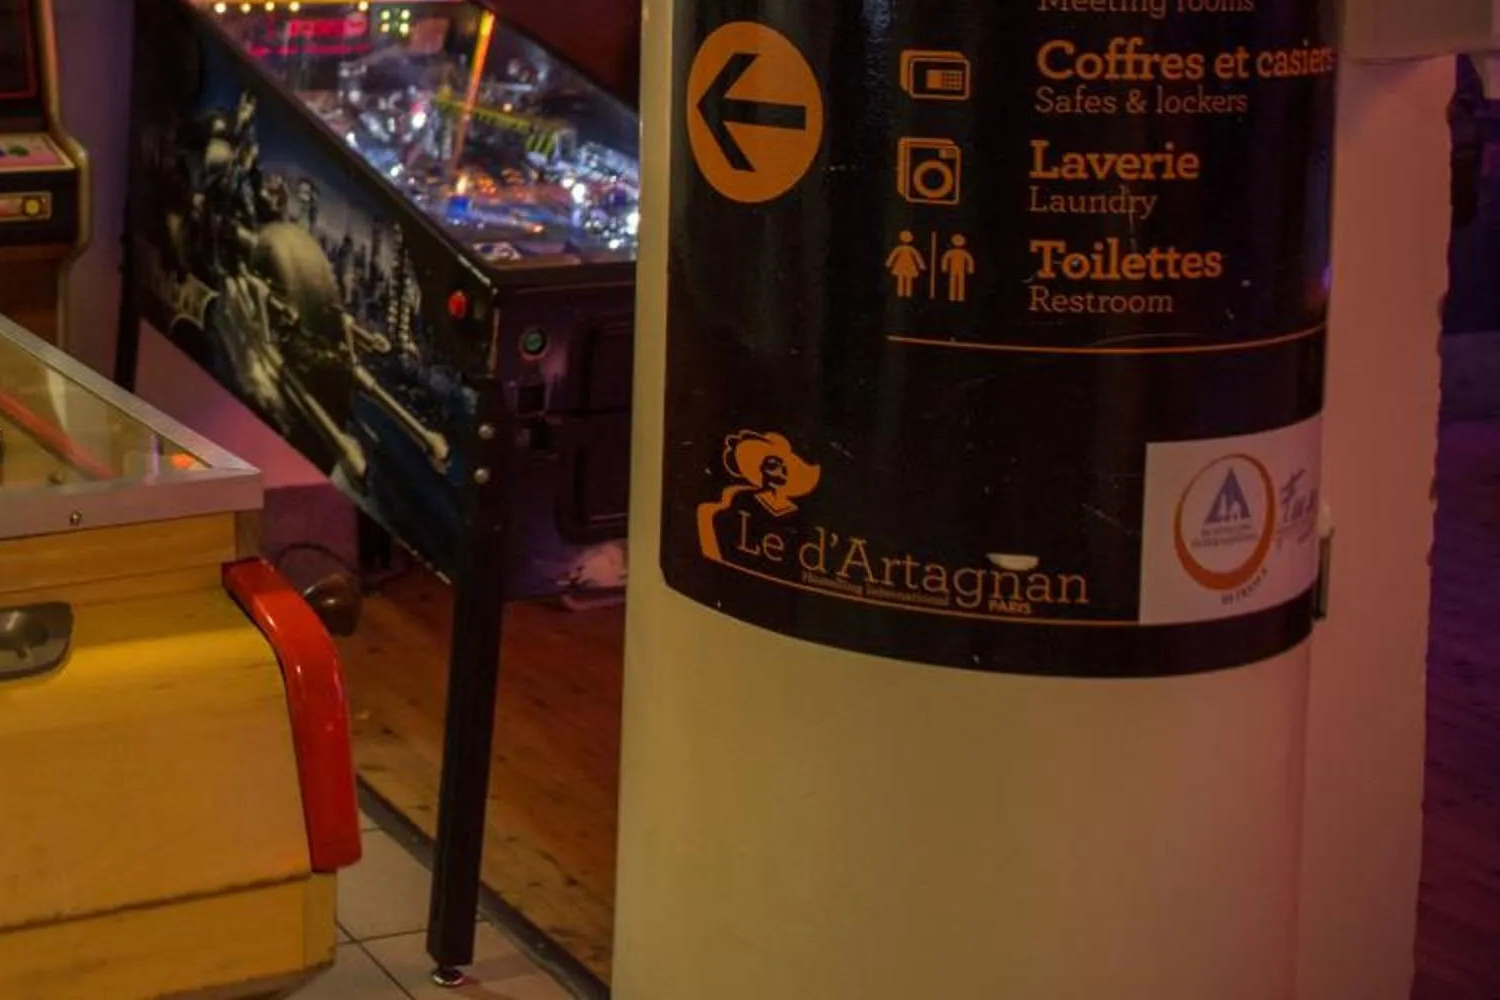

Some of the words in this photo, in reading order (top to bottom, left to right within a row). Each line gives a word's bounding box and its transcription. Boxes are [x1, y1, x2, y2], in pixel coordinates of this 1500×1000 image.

[1037, 36, 1206, 80] Coffres
[1214, 45, 1250, 79] et
[1034, 85, 1118, 114] Safes
[1125, 88, 1147, 114] &
[1156, 86, 1249, 114] lockers
[1028, 140, 1201, 180] Laverie
[1027, 185, 1158, 220] Laundry
[1029, 237, 1225, 280] Toilettes
[1027, 285, 1174, 313] Restroom
[736, 510, 785, 562] Le
